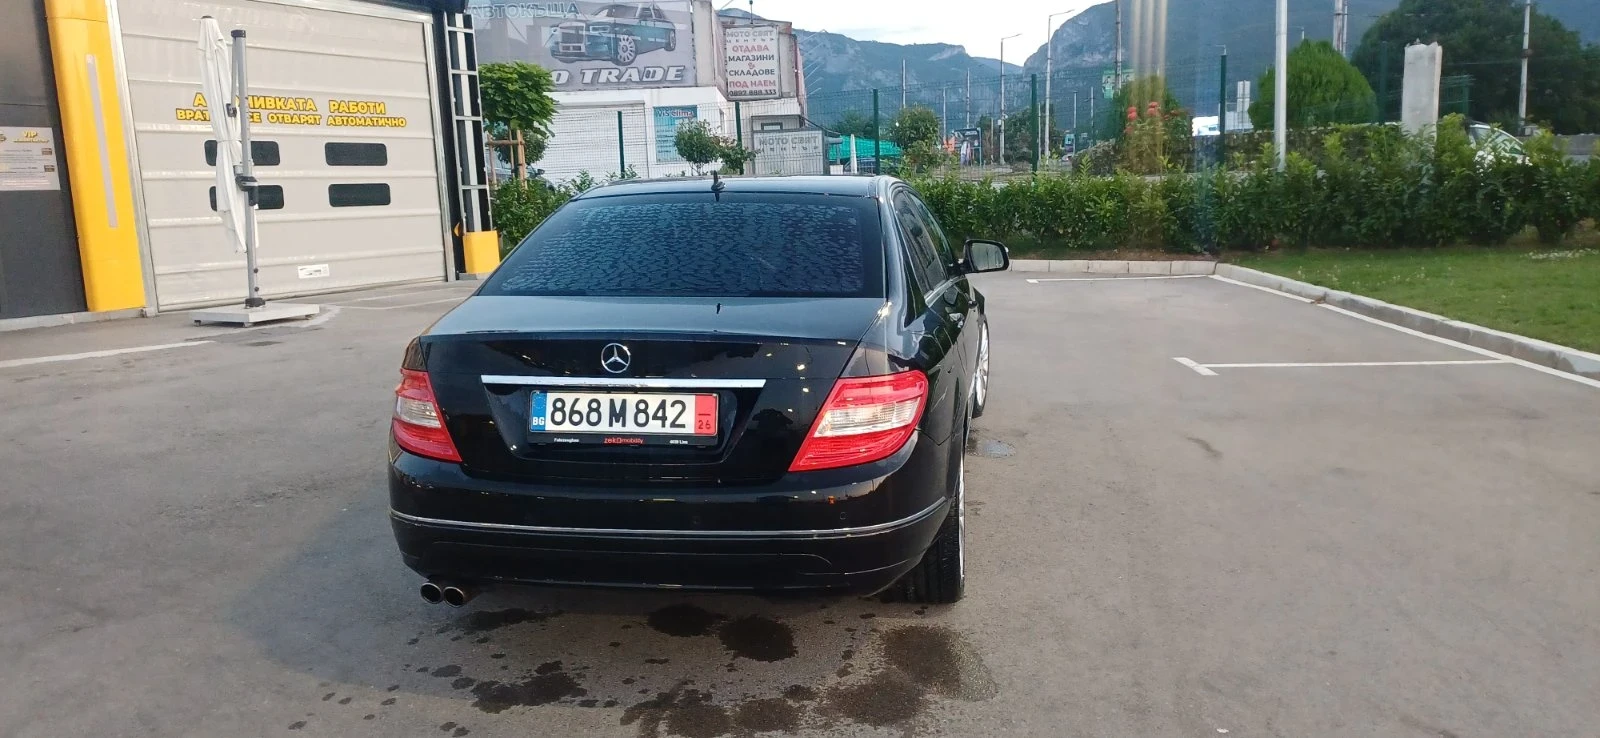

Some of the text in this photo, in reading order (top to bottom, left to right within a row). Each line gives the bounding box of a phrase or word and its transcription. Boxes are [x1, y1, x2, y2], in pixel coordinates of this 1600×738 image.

[470, 3, 581, 19] АВТОКЪЩА
[732, 44, 770, 53] ОТДАВА
[728, 54, 775, 62] МАГАЗИНИ
[580, 65, 686, 84] TRADE
[728, 68, 776, 77] СКЛАДОВЕ
[729, 79, 777, 89] ПОД НАЕМ
[764, 88, 777, 96] 333
[328, 100, 386, 115] РАБОТИ
[267, 112, 322, 125] ОТВАРЯТ
[326, 115, 407, 128] АВТОМАТИЧНО
[24, 130, 38, 139] VIP
[759, 136, 818, 145] МОТО СВЯТ
[551, 397, 687, 428] 868 M 842
[532, 416, 711, 430] BG 26
